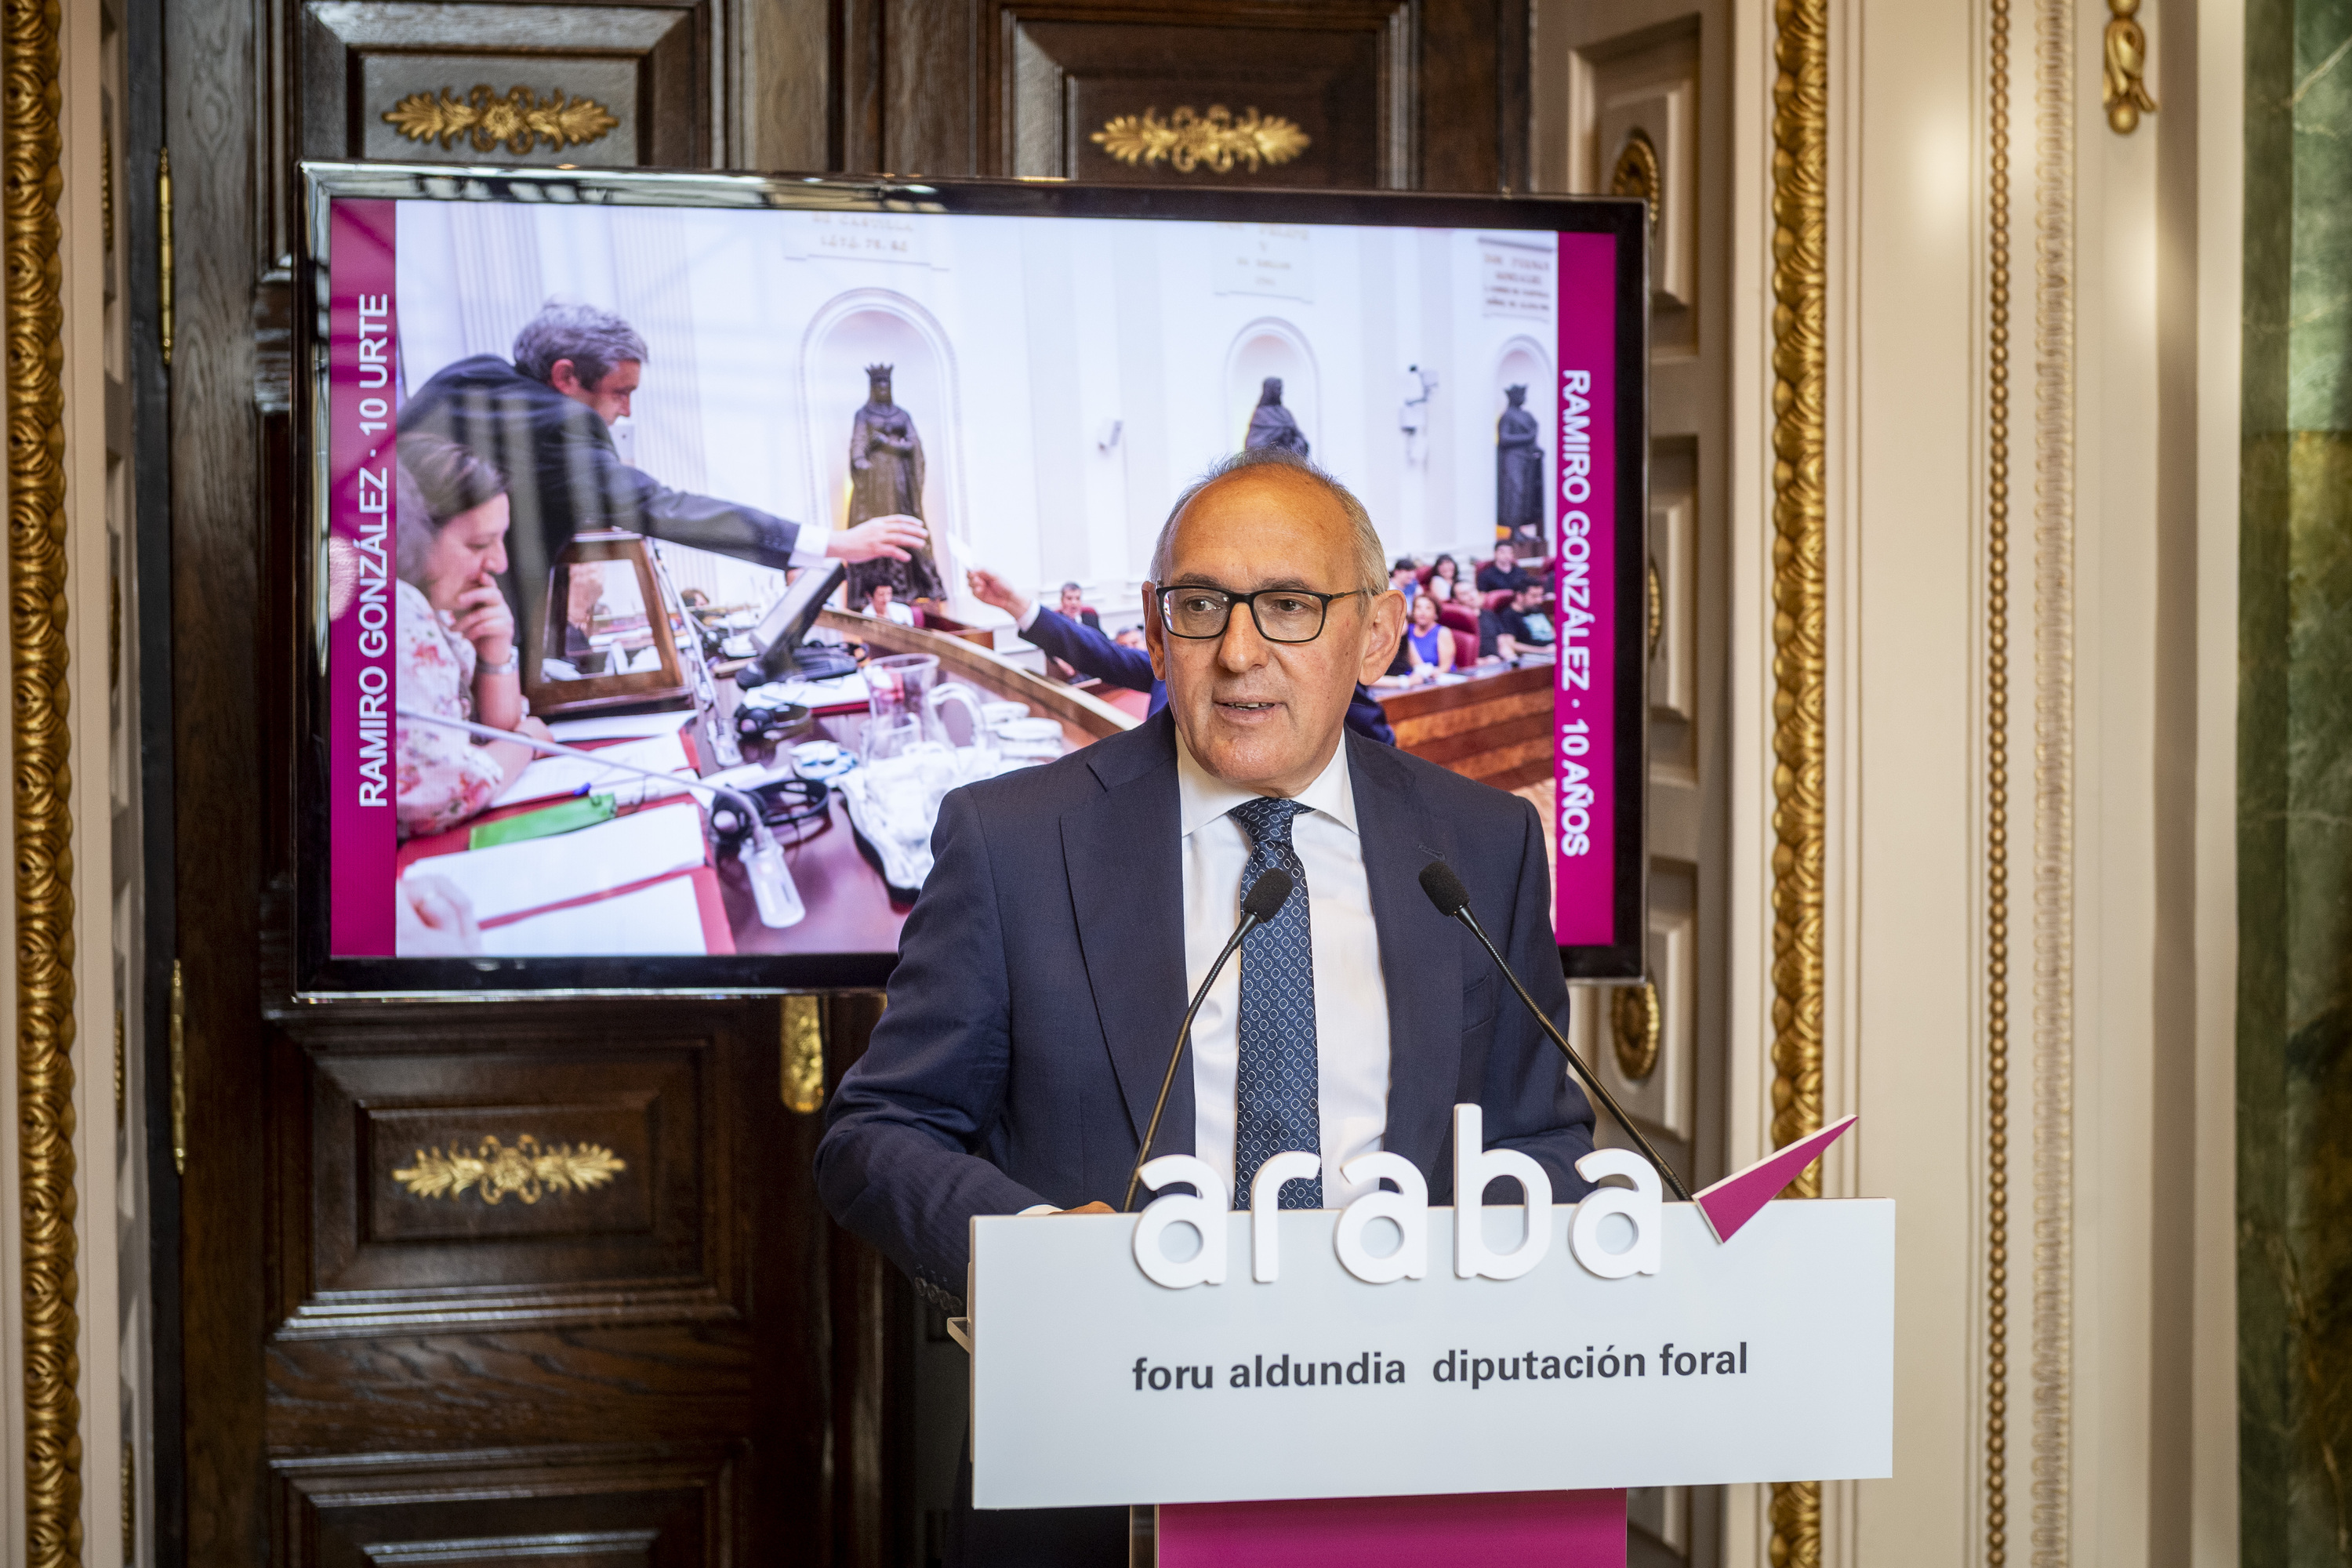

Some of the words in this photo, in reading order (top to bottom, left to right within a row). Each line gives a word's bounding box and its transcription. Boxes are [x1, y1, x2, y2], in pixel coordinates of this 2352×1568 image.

[358, 293, 387, 389] URTE
[358, 397, 387, 435] 10
[1562, 369, 1591, 503] RAMIRO
[352, 466, 387, 658] GONZÁLEZ
[1562, 510, 1595, 691] GONZÁLEZ
[358, 666, 387, 807] RAMIRO
[1562, 719, 1589, 756] 10
[1562, 760, 1594, 856] AÑOS
[1133, 1103, 1663, 1288] araba
[1132, 1356, 1213, 1391] foru
[1229, 1351, 1405, 1388] aldundia
[1432, 1345, 1646, 1389] diputación
[1658, 1341, 1748, 1376] foral
